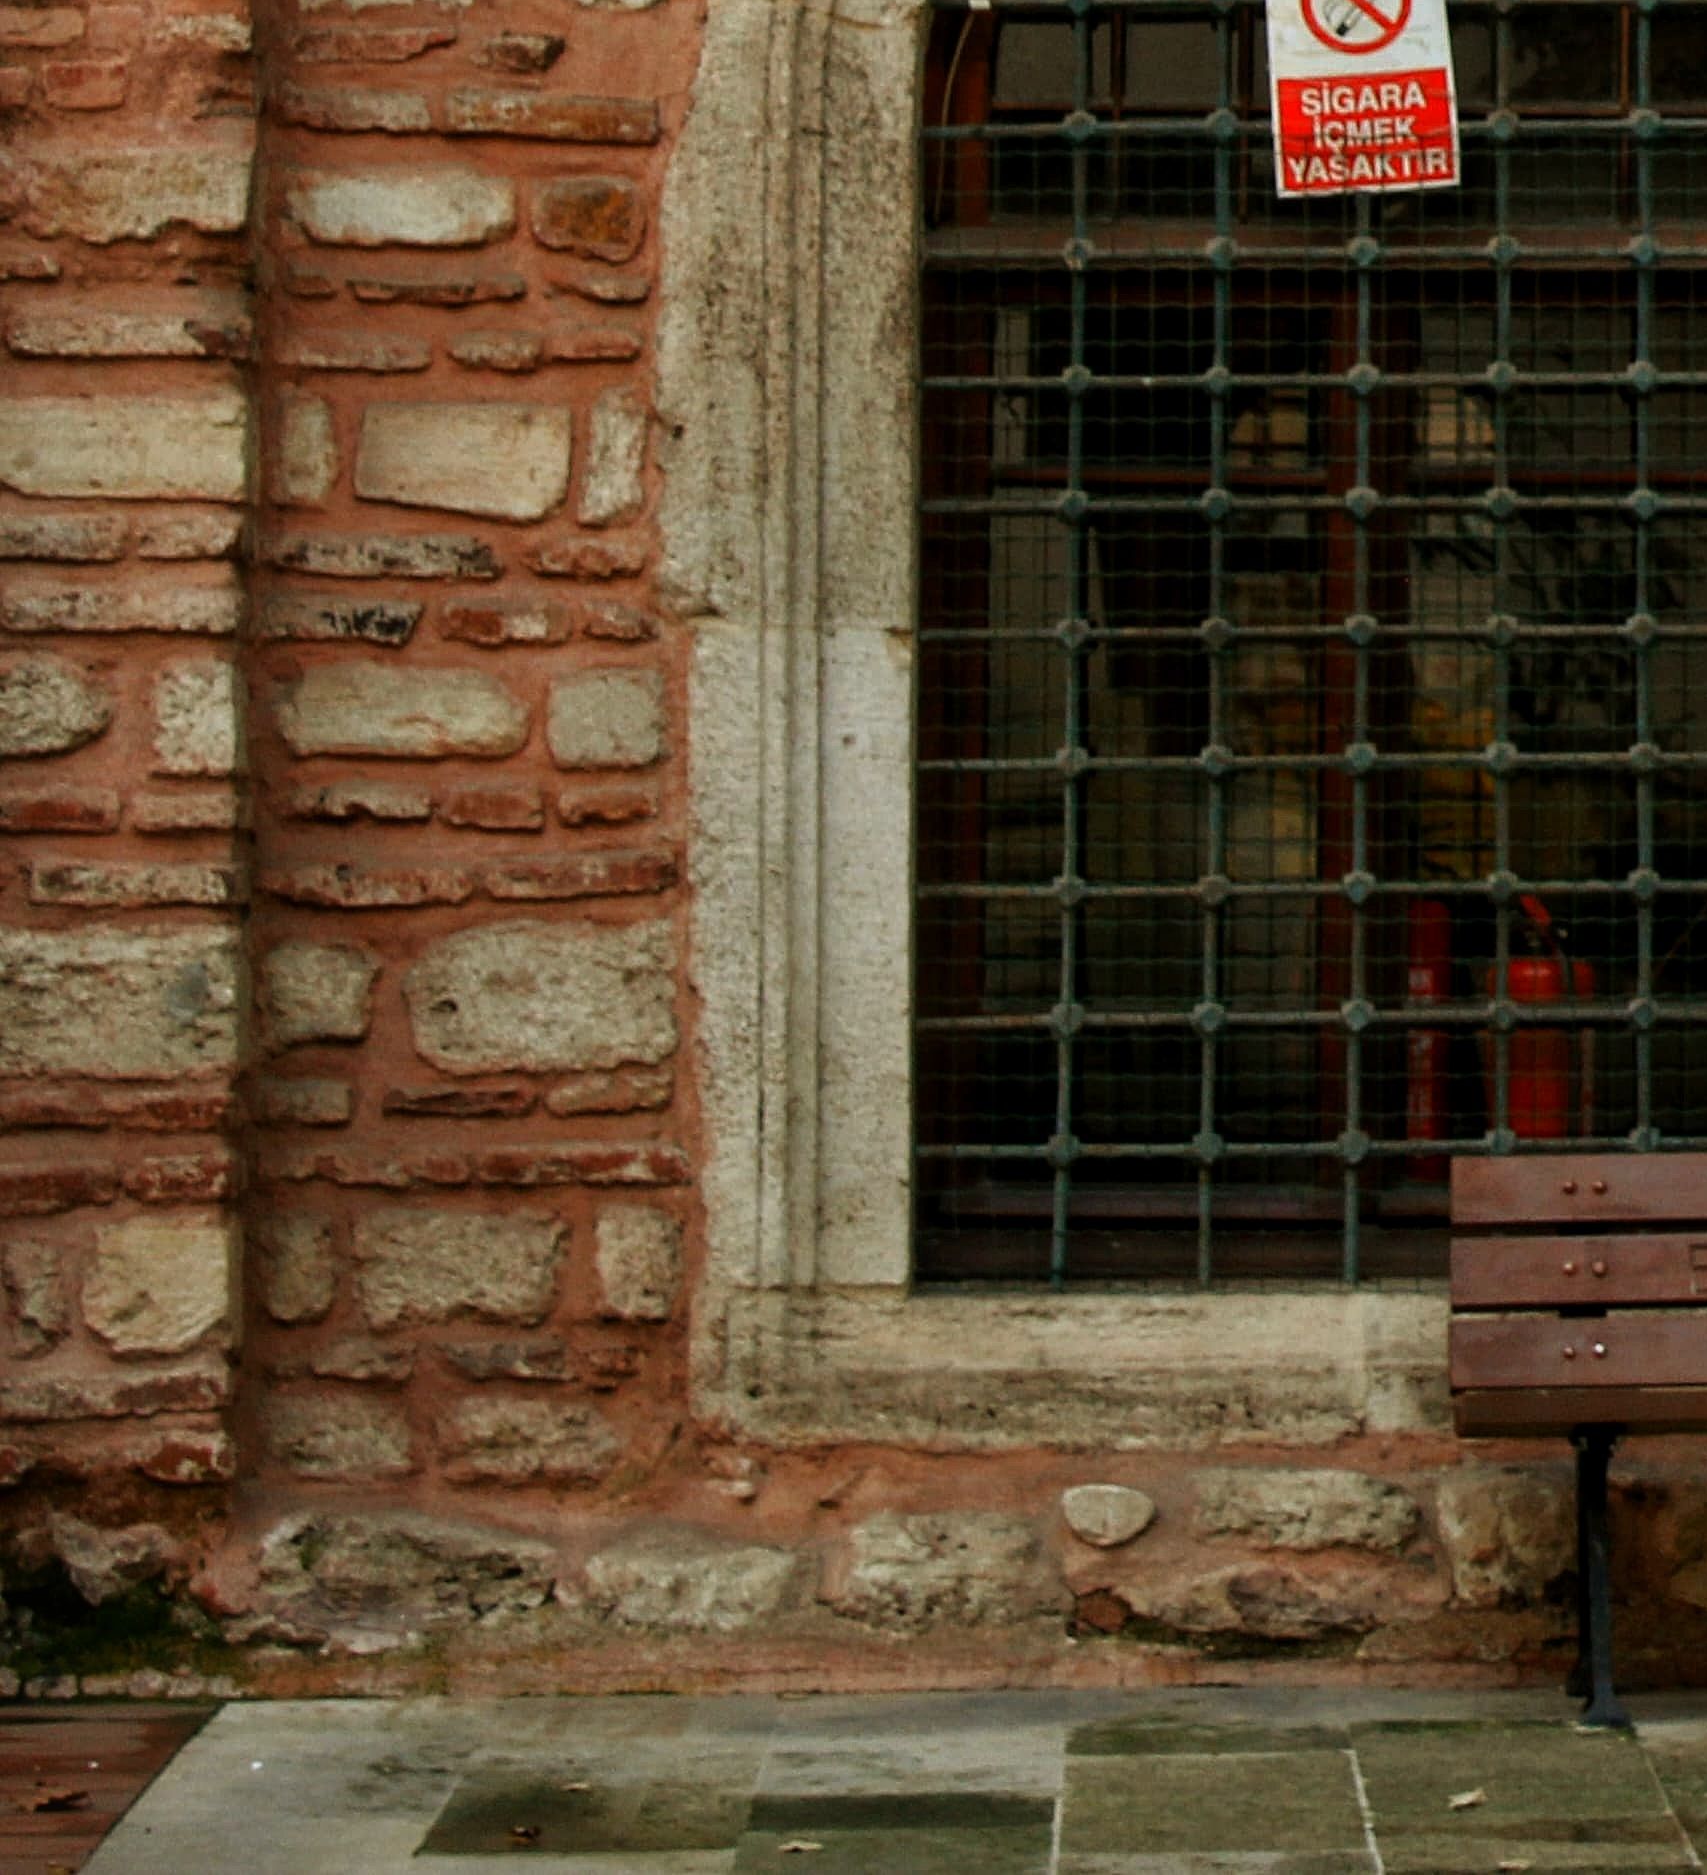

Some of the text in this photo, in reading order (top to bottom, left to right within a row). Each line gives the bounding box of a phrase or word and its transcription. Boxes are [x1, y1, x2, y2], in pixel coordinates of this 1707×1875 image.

[1300, 80, 1427, 116] SİGARA
[1313, 115, 1419, 150] İÇMEK
[1288, 147, 1449, 184] YASAKTIR
